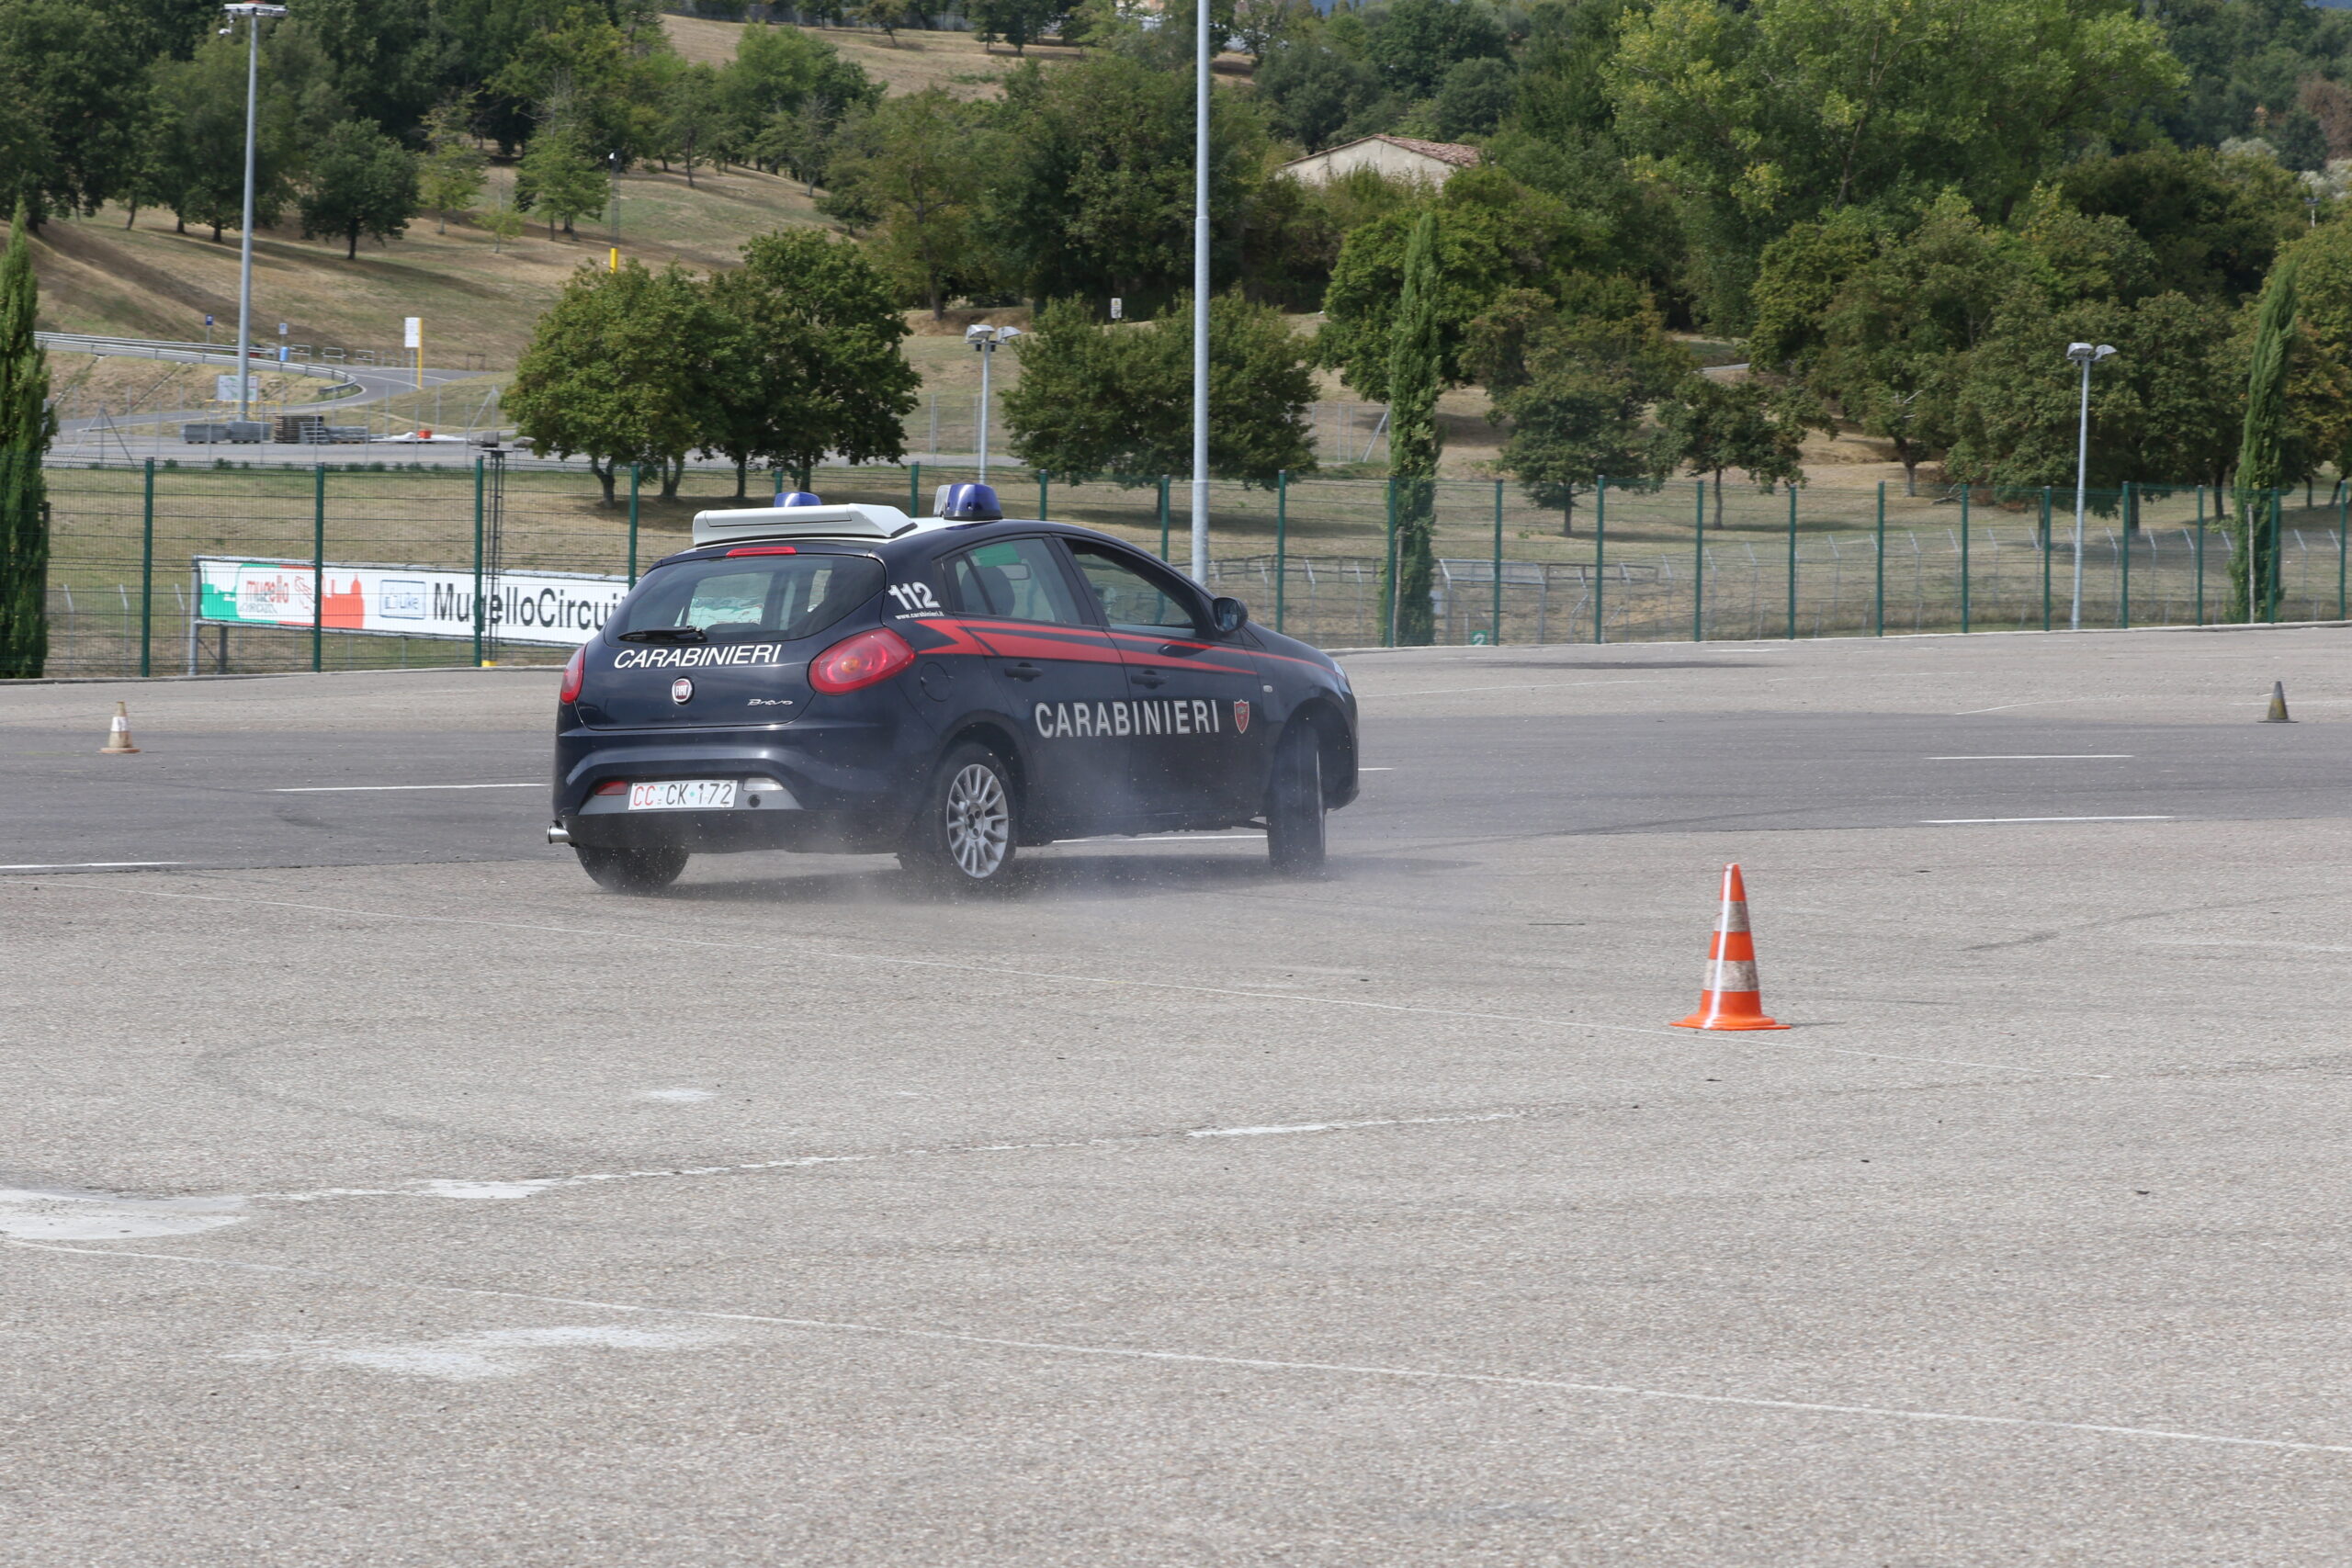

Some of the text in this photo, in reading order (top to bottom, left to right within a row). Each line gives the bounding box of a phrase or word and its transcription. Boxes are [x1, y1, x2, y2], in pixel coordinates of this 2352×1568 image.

[434, 582, 624, 632] MuelloCircu
[888, 581, 941, 610] 112
[895, 611, 944, 620] www.carabinieri.it
[614, 644, 782, 669] CARABINIERI
[675, 684, 688, 696] FIAT
[747, 698, 793, 706] Bravo
[1035, 699, 1220, 739] CARABINIERI
[634, 783, 732, 807] CC CK 172
